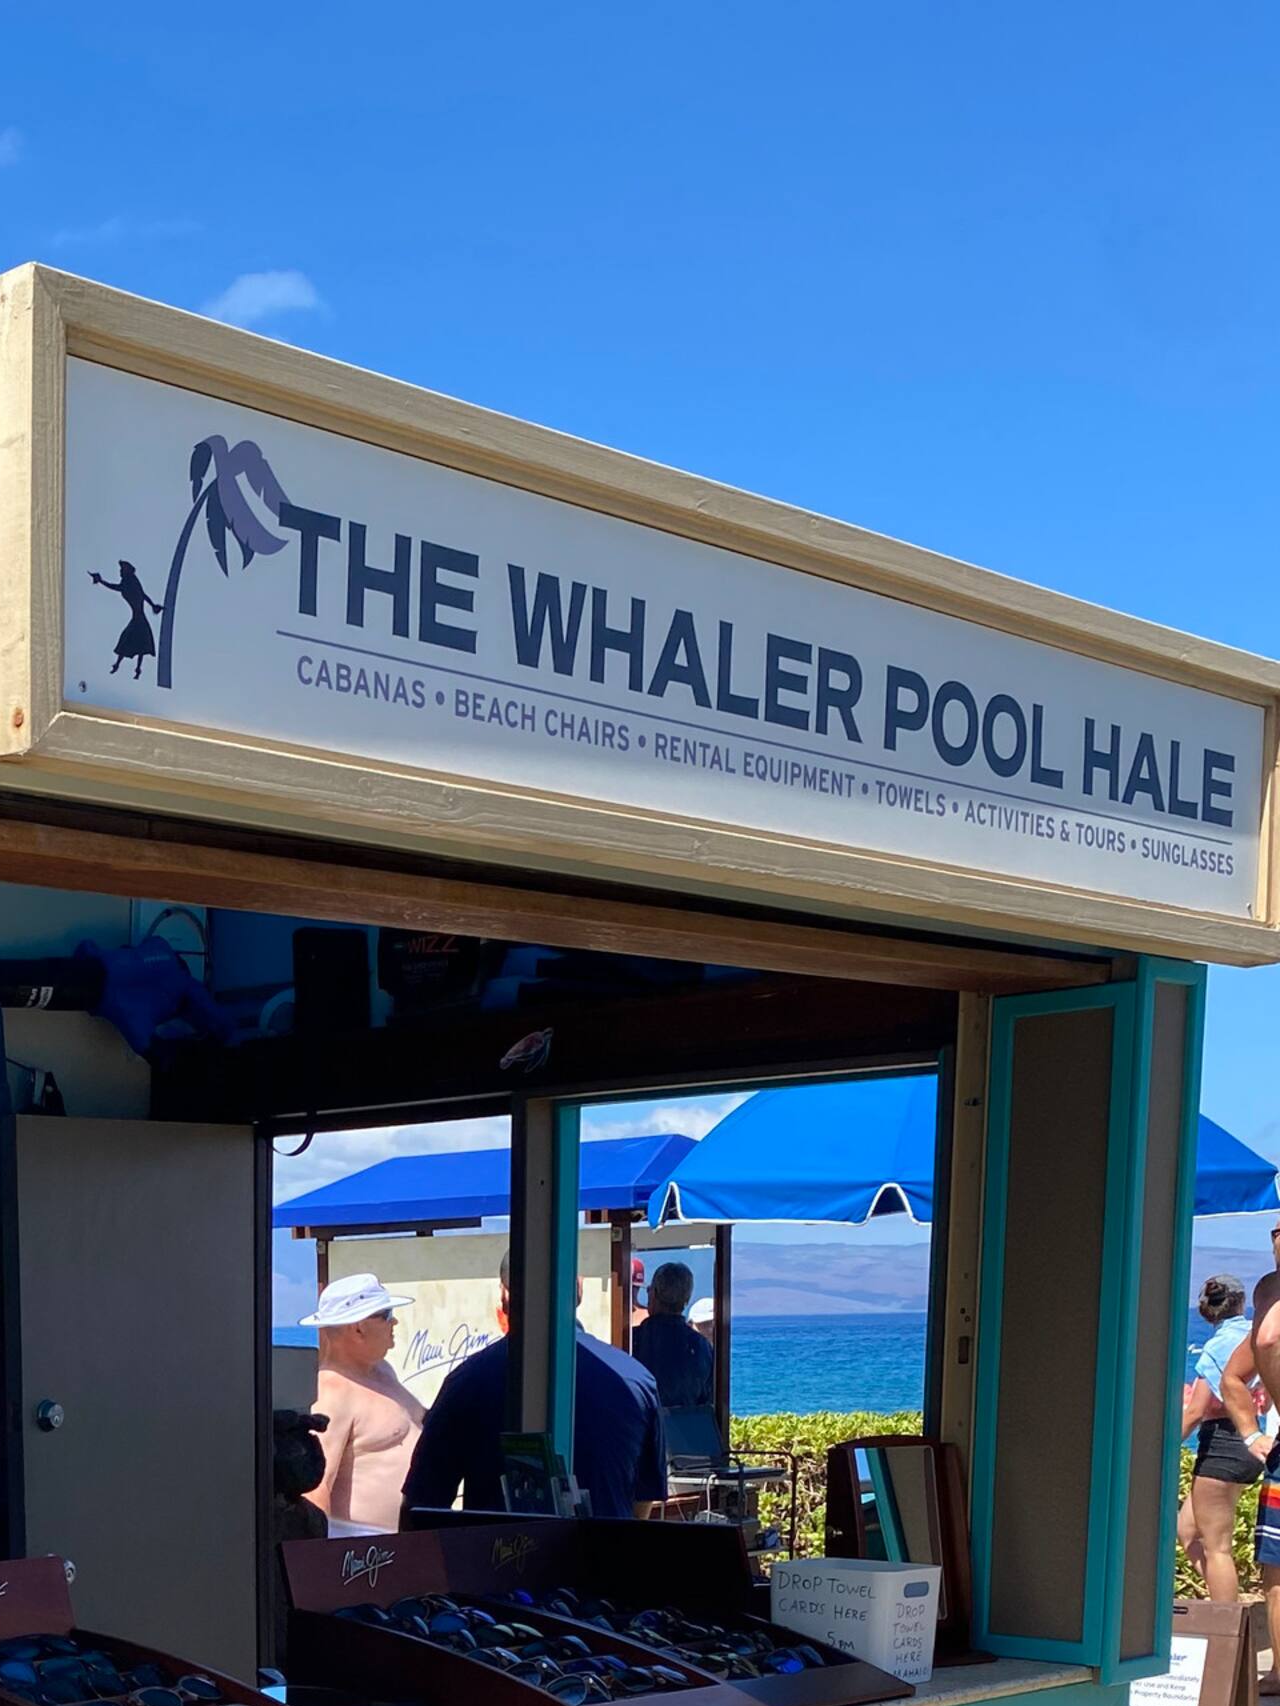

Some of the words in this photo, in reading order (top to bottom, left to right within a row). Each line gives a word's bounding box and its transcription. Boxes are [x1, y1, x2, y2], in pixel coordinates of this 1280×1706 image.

[278, 501, 480, 655] THE
[507, 563, 863, 743] WHALER
[883, 664, 1064, 790] POOL
[1082, 717, 1236, 828] HALE
[296, 654, 426, 709] CABANAS
[455, 688, 537, 733] BEACH
[544, 708, 630, 752] CHAIRS
[655, 732, 736, 775] RENTAL
[743, 752, 855, 798] EQUIPMENT
[876, 780, 946, 817] TOWELS
[965, 799, 1055, 842] ACTIVITIES
[1060, 818, 1070, 842] &
[1075, 822, 1126, 854] TOURS
[1141, 836, 1234, 877] SUNGLASSES
[403, 1326, 445, 1371] Maui
[449, 1323, 500, 1372] Jim
[778, 1571, 822, 1591] DROP
[826, 1578, 877, 1600] TOWEL
[834, 1605, 868, 1621] HERE
[896, 1603, 925, 1619] DROP
[894, 1622, 926, 1635] TOWEL
[893, 1637, 924, 1650] CARDS
[896, 1651, 922, 1665] HERE
